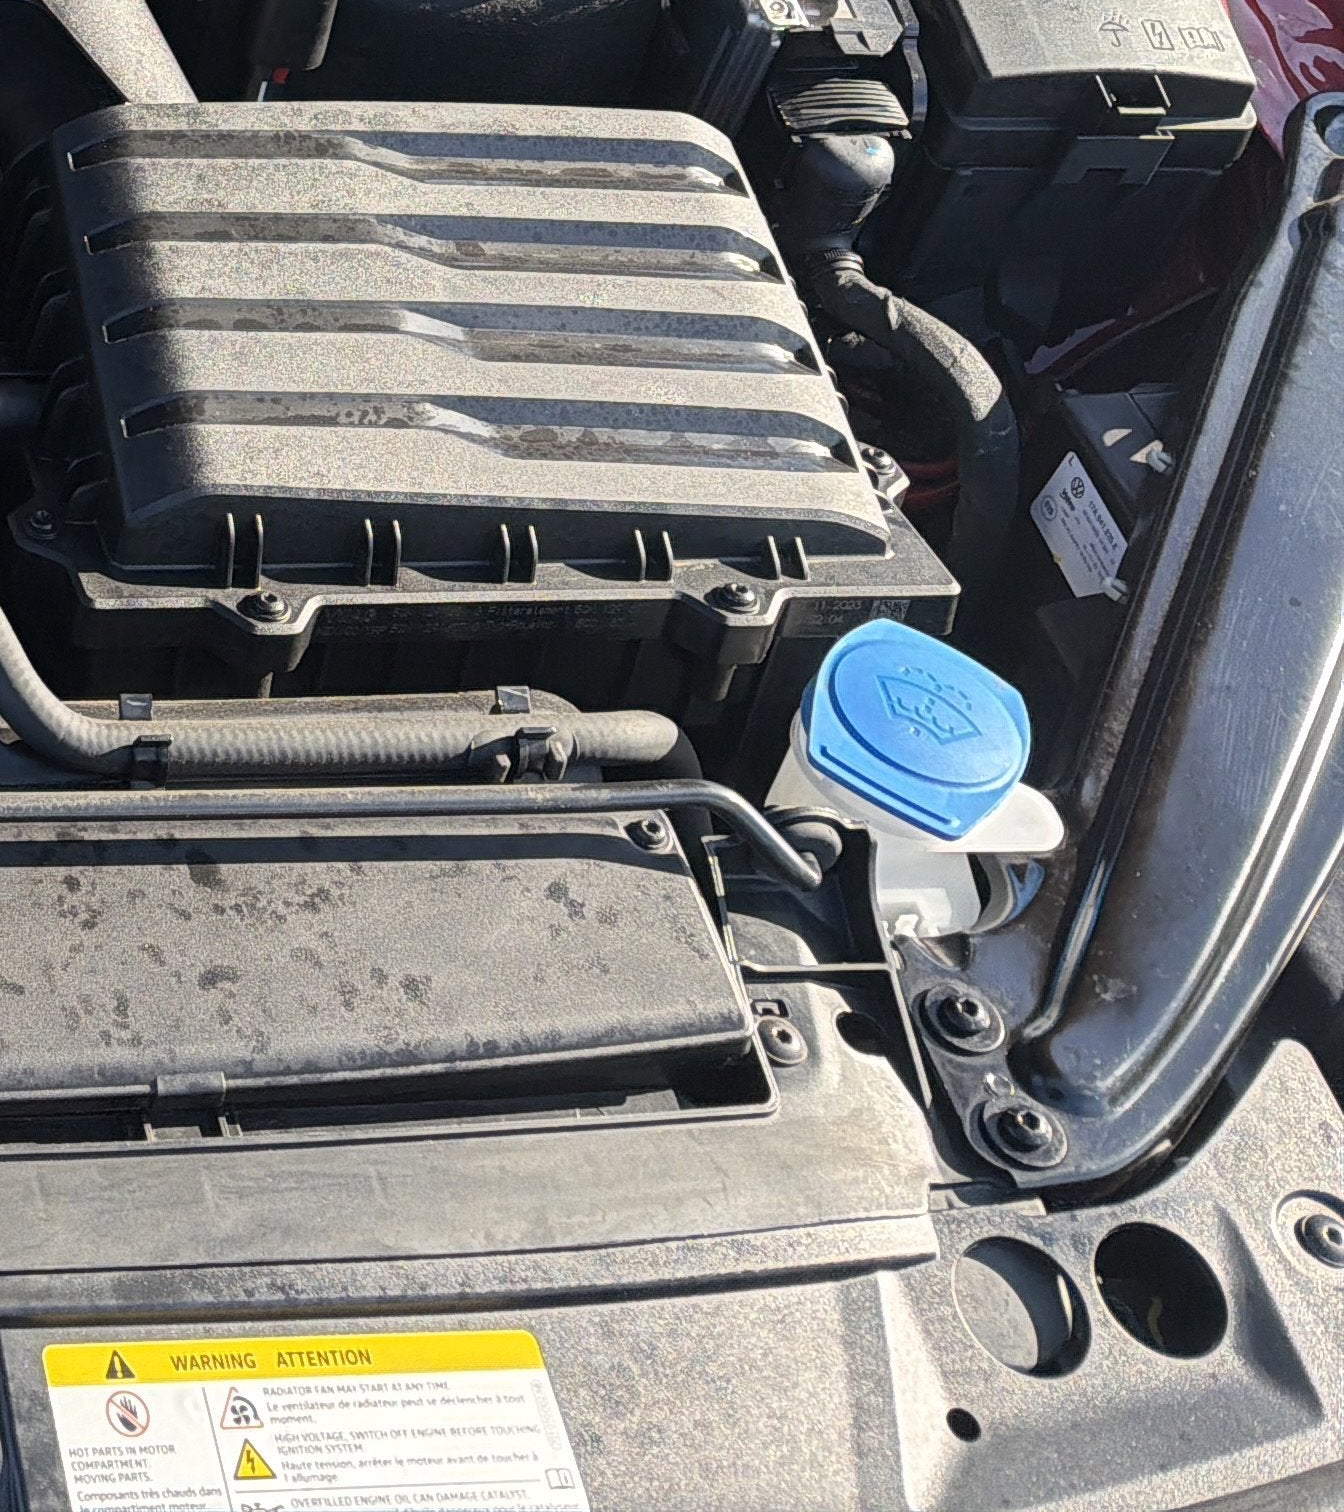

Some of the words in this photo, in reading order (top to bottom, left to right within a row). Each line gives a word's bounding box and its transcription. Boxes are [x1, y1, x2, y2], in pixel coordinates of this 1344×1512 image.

[170, 1353, 257, 1371] WARNING
[277, 1349, 371, 1368] ATTENTION
[263, 1386, 313, 1396] RADIATOR
[315, 1385, 335, 1395] FAN
[337, 1384, 357, 1394] MAY
[359, 1383, 389, 1393] START
[405, 1382, 424, 1391] ANY
[267, 1402, 279, 1412] Le
[281, 1399, 335, 1411] ventilateur
[338, 1399, 350, 1409] de
[353, 1398, 398, 1409] radiateur
[401, 1397, 424, 1408] peut
[503, 1394, 525, 1404] tout
[275, 1434, 300, 1444] HIGH
[349, 1431, 388, 1441] SWITCH
[391, 1429, 408, 1439] OFF
[411, 1428, 447, 1438] ENGINE
[449, 1427, 488, 1437] BEFORE
[490, 1425, 541, 1436] TOUCHING
[69, 1447, 89, 1458] HOT
[92, 1446, 125, 1457] PARTS
[126, 1446, 137, 1455] IN
[139, 1444, 176, 1455] MOTOR
[277, 1445, 323, 1456] IGNITION
[281, 1461, 312, 1471] Haute
[358, 1457, 393, 1468] arrêter
[407, 1457, 444, 1466] moteur
[446, 1455, 474, 1466] avant
[477, 1454, 489, 1464] de
[492, 1453, 530, 1463] toucher
[74, 1473, 117, 1484] MOVING
[77, 1489, 140, 1503] Composants
[141, 1488, 159, 1498] très
[161, 1486, 197, 1498] chauds
[199, 1486, 223, 1498] dans
[291, 1496, 352, 1508] OVERFILLED
[354, 1494, 391, 1506] ENGINE
[395, 1494, 410, 1504] OIL
[414, 1492, 434, 1503] CAN
[437, 1491, 477, 1502] DAMAGE
[168, 1502, 206, 1511] moteur
